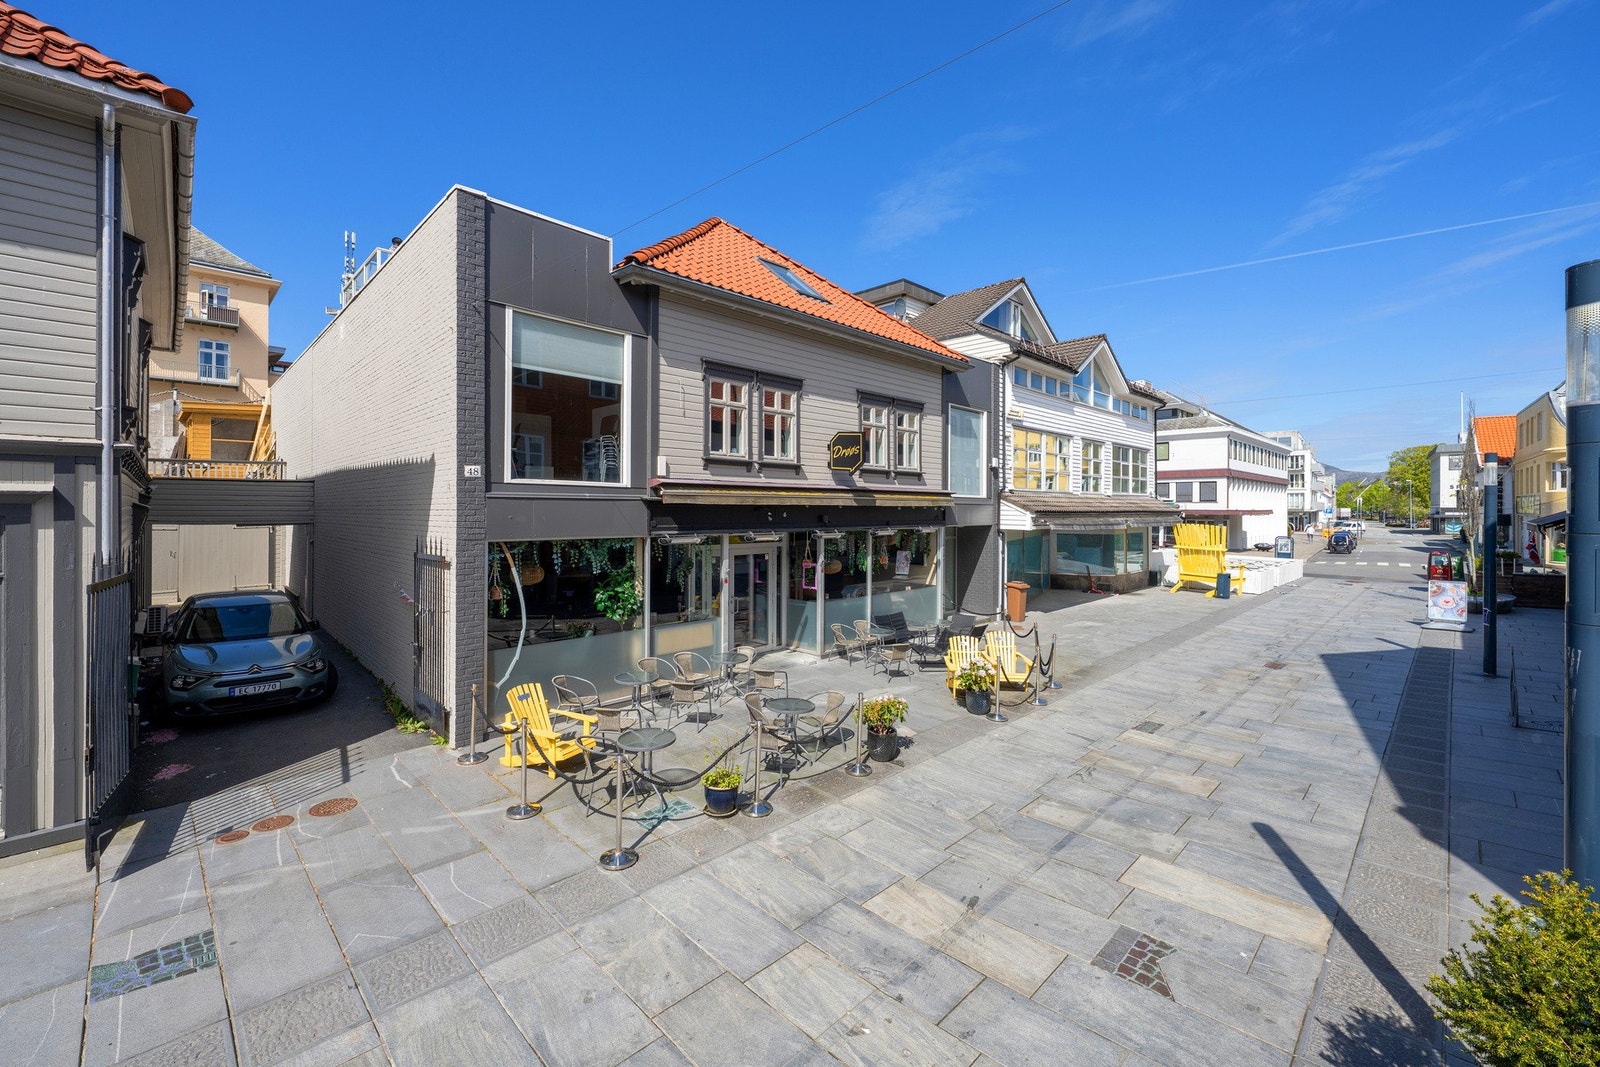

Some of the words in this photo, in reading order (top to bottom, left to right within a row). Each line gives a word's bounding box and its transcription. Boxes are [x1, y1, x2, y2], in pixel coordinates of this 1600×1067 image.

[466, 467, 480, 476] 48
[238, 687, 248, 695] EC
[253, 683, 277, 693] 17770
